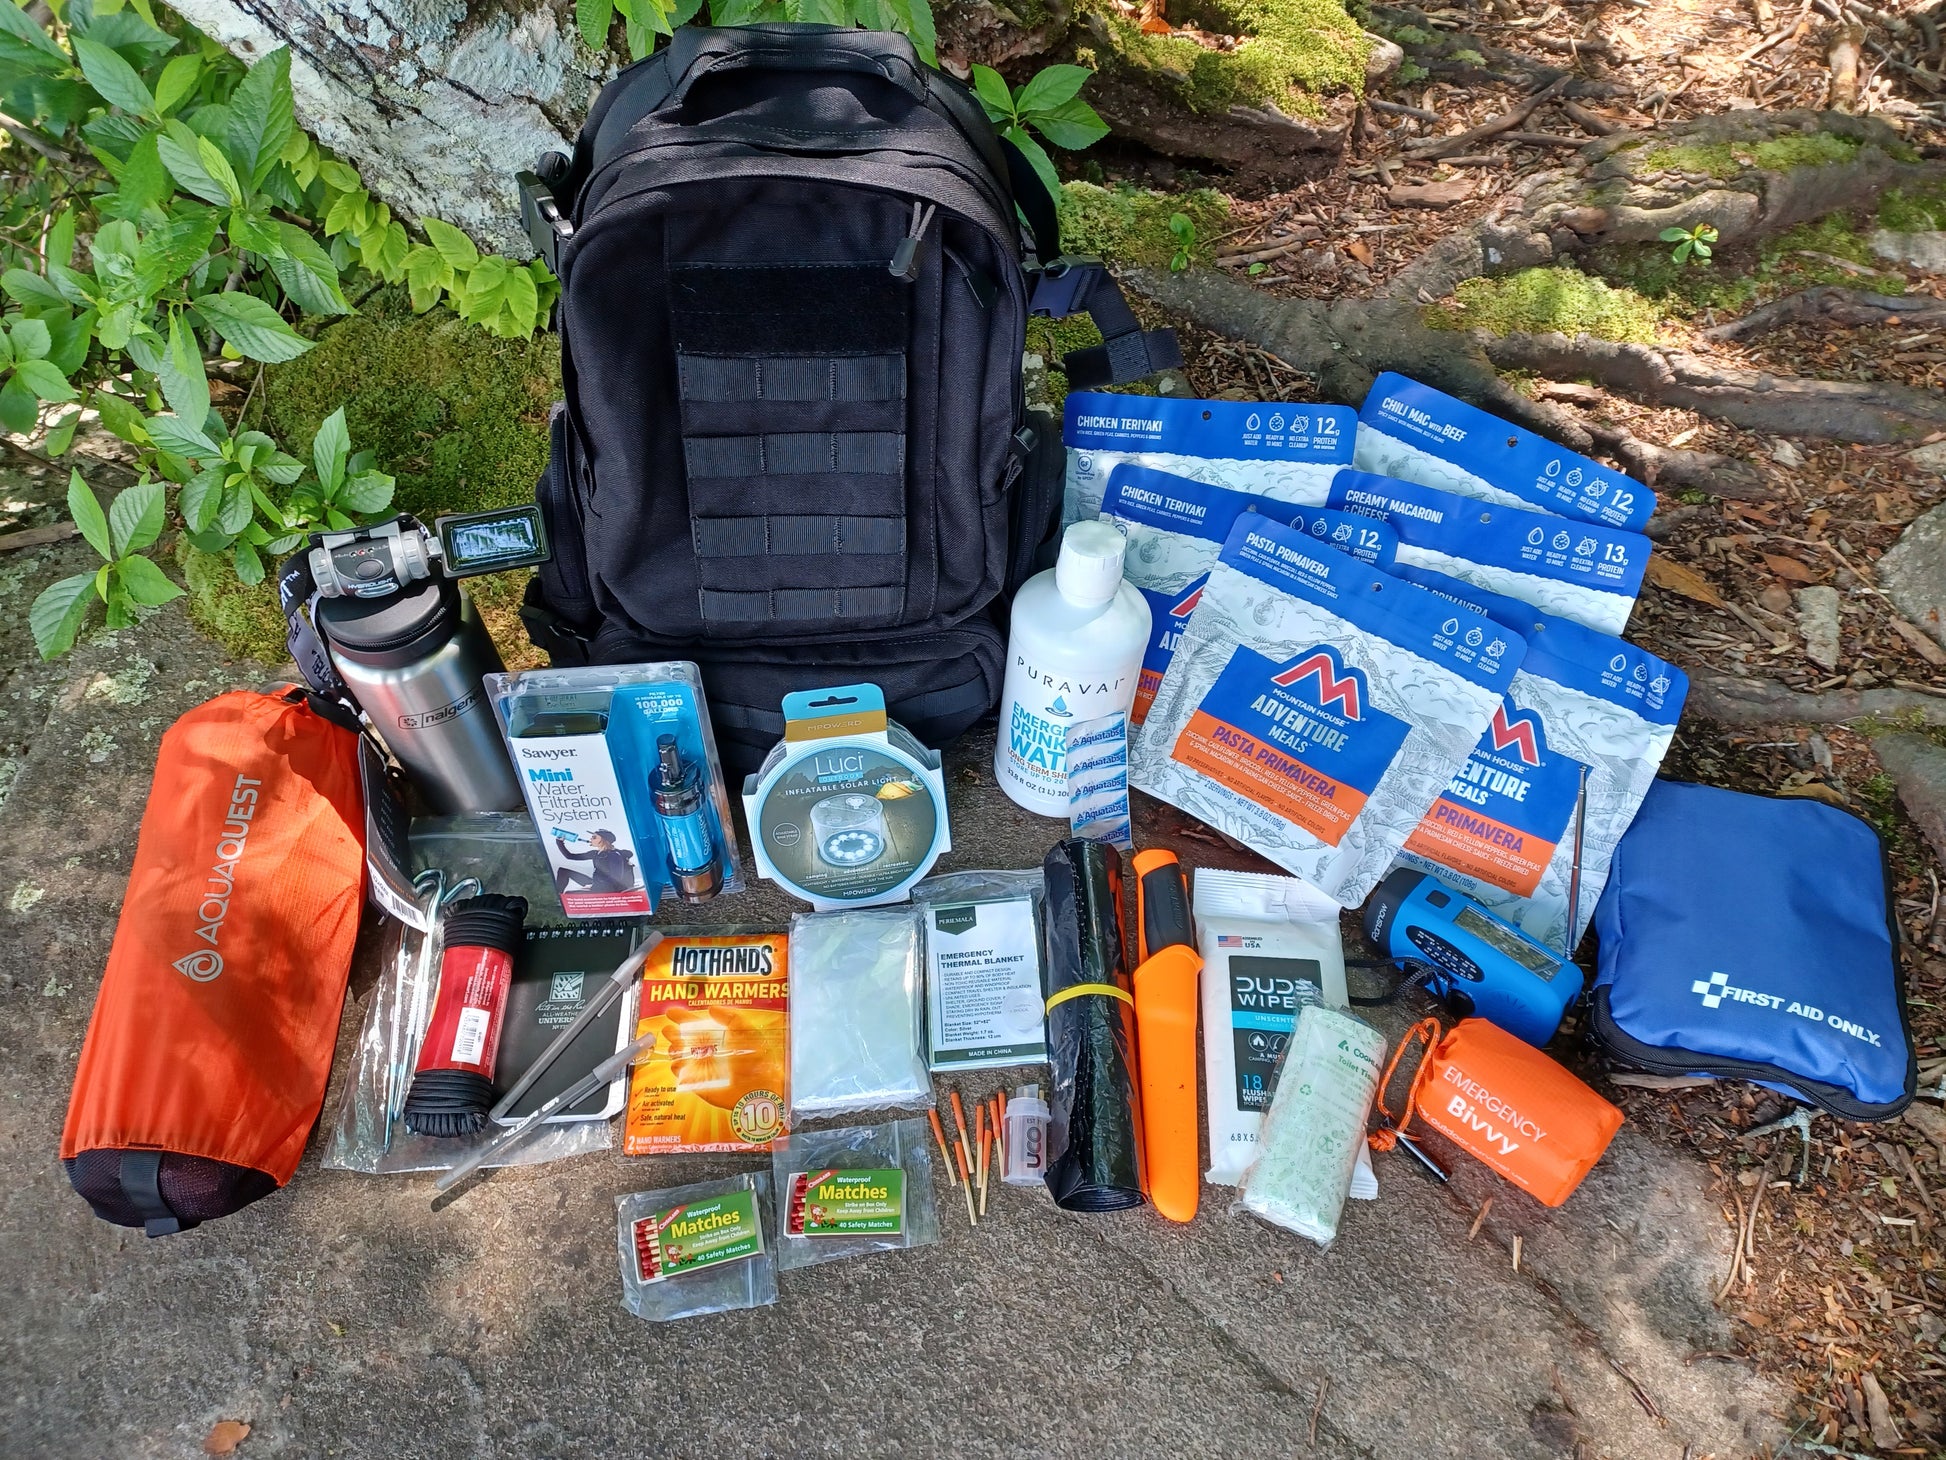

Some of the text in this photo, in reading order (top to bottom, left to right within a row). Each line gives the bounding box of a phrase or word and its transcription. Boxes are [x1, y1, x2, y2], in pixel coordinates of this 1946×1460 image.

[1077, 415, 1163, 432] CHICKEN TERIYAKI
[1382, 397, 1467, 442] CHILI MAC WITH BEEF
[1313, 437, 1338, 446] PROTEIN
[1121, 485, 1163, 506] CHICKEN
[1165, 497, 1207, 518] TERIYAKI
[1345, 489, 1444, 524] CREAMY MACARONI
[1351, 505, 1389, 523] CHEESE
[1602, 507, 1628, 523] PROTEIN
[1245, 532, 1276, 554] PASTA
[1276, 546, 1330, 579] PRIMAVERA
[1353, 547, 1377, 560] PROTEIN
[1597, 562, 1625, 576] PROTEIN
[1017, 656, 1119, 695] PURAVAI
[425, 695, 476, 723] nalgen
[1272, 688, 1347, 728] MOUNTAIN HOUSE
[1013, 701, 1066, 736] EMERG
[1250, 694, 1349, 753] ADVENTURE
[1011, 714, 1066, 752] DRINK
[1081, 729, 1120, 743] Aquatabs
[1268, 725, 1309, 753] MEALS
[1010, 727, 1065, 771] WAT
[815, 752, 864, 775] Luci
[1007, 746, 1068, 780] LONG TERM SHE
[1082, 754, 1121, 769] Aquatabs
[1212, 725, 1255, 757] PASTA
[1255, 748, 1336, 800] PRIMAVERA
[1474, 748, 1526, 773] TAIN HOUSE
[528, 767, 573, 782] Mini
[1457, 759, 1531, 802] ENTURE
[532, 782, 585, 796] Water
[785, 776, 898, 796] INFLATABLE SOLAR LIGHT
[1082, 779, 1121, 794] Aquatabs
[1208, 781, 1248, 808] SERVINGS NET
[1445, 778, 1490, 805] MEALS
[537, 794, 612, 809] Filtration
[542, 808, 607, 825] System
[1085, 804, 1122, 819] Aquatabs
[1436, 804, 1524, 853] PRIMAVERA
[194, 774, 262, 946] AQUAQUEST
[672, 945, 773, 977] HOTHANDS
[941, 949, 994, 960] EMERGENCY
[941, 955, 1025, 969] THERMAL BLANKET
[650, 982, 788, 1002] HAND WARMERS
[1721, 985, 1785, 1010] FIRST
[1786, 1001, 1824, 1022] AID
[1255, 1015, 1294, 1024] UNSCENTE
[1338, 1055, 1359, 1072] Toilet
[1353, 1048, 1379, 1067] COGHL
[644, 1086, 660, 1094] Ready
[1243, 1074, 1263, 1090] 18
[1443, 1065, 1547, 1143] EMERGENCY
[744, 1102, 777, 1132] 10
[1447, 1095, 1520, 1155] Bivvy
[1230, 1133, 1249, 1142] 6.8 X
[1430, 1117, 1469, 1146] outdoor
[627, 1136, 636, 1151] 2
[836, 1176, 871, 1184] Waterproof
[819, 1183, 888, 1200] Matches
[686, 1203, 721, 1219] Waterproof
[671, 1210, 740, 1239] Matches
[730, 1225, 742, 1233] Only
[731, 1230, 750, 1238] Children
[848, 1221, 867, 1229] Safety
[706, 1251, 725, 1260] Safety
[726, 1243, 751, 1254] Matches
